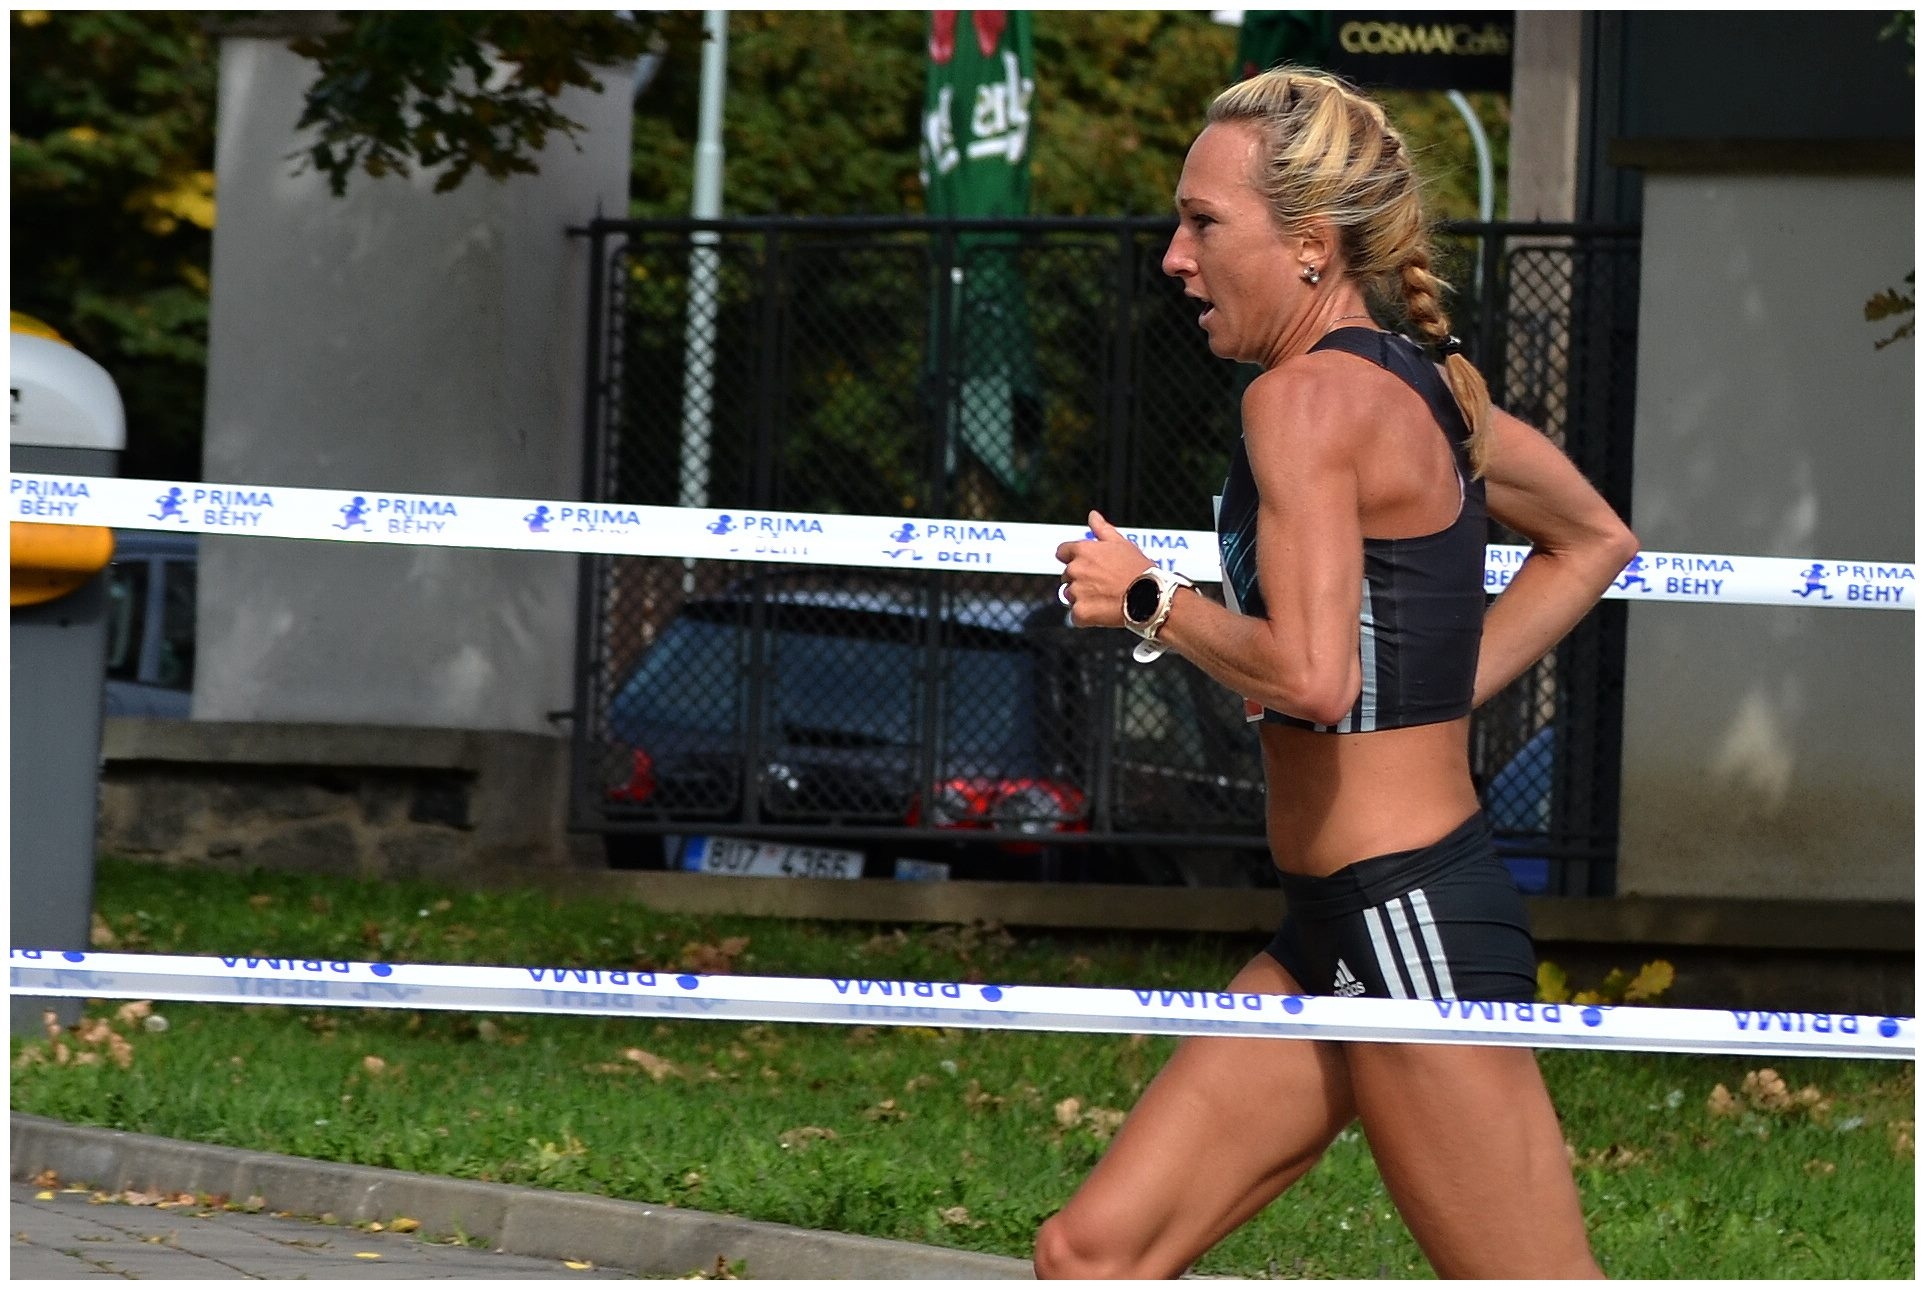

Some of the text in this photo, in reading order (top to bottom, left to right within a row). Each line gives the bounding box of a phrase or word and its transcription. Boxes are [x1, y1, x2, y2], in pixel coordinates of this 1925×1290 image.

[10, 479, 90, 498] PRIMA
[193, 489, 273, 507] PRIMA
[377, 498, 457, 516] PRIMA
[561, 507, 641, 525] PRIMA
[744, 516, 823, 533] PRIMA
[927, 525, 1006, 542] PRIMA
[1127, 534, 1188, 549] RIMA
[1655, 557, 1735, 573] PRIMA
[1836, 565, 1915, 580] PRIMA
